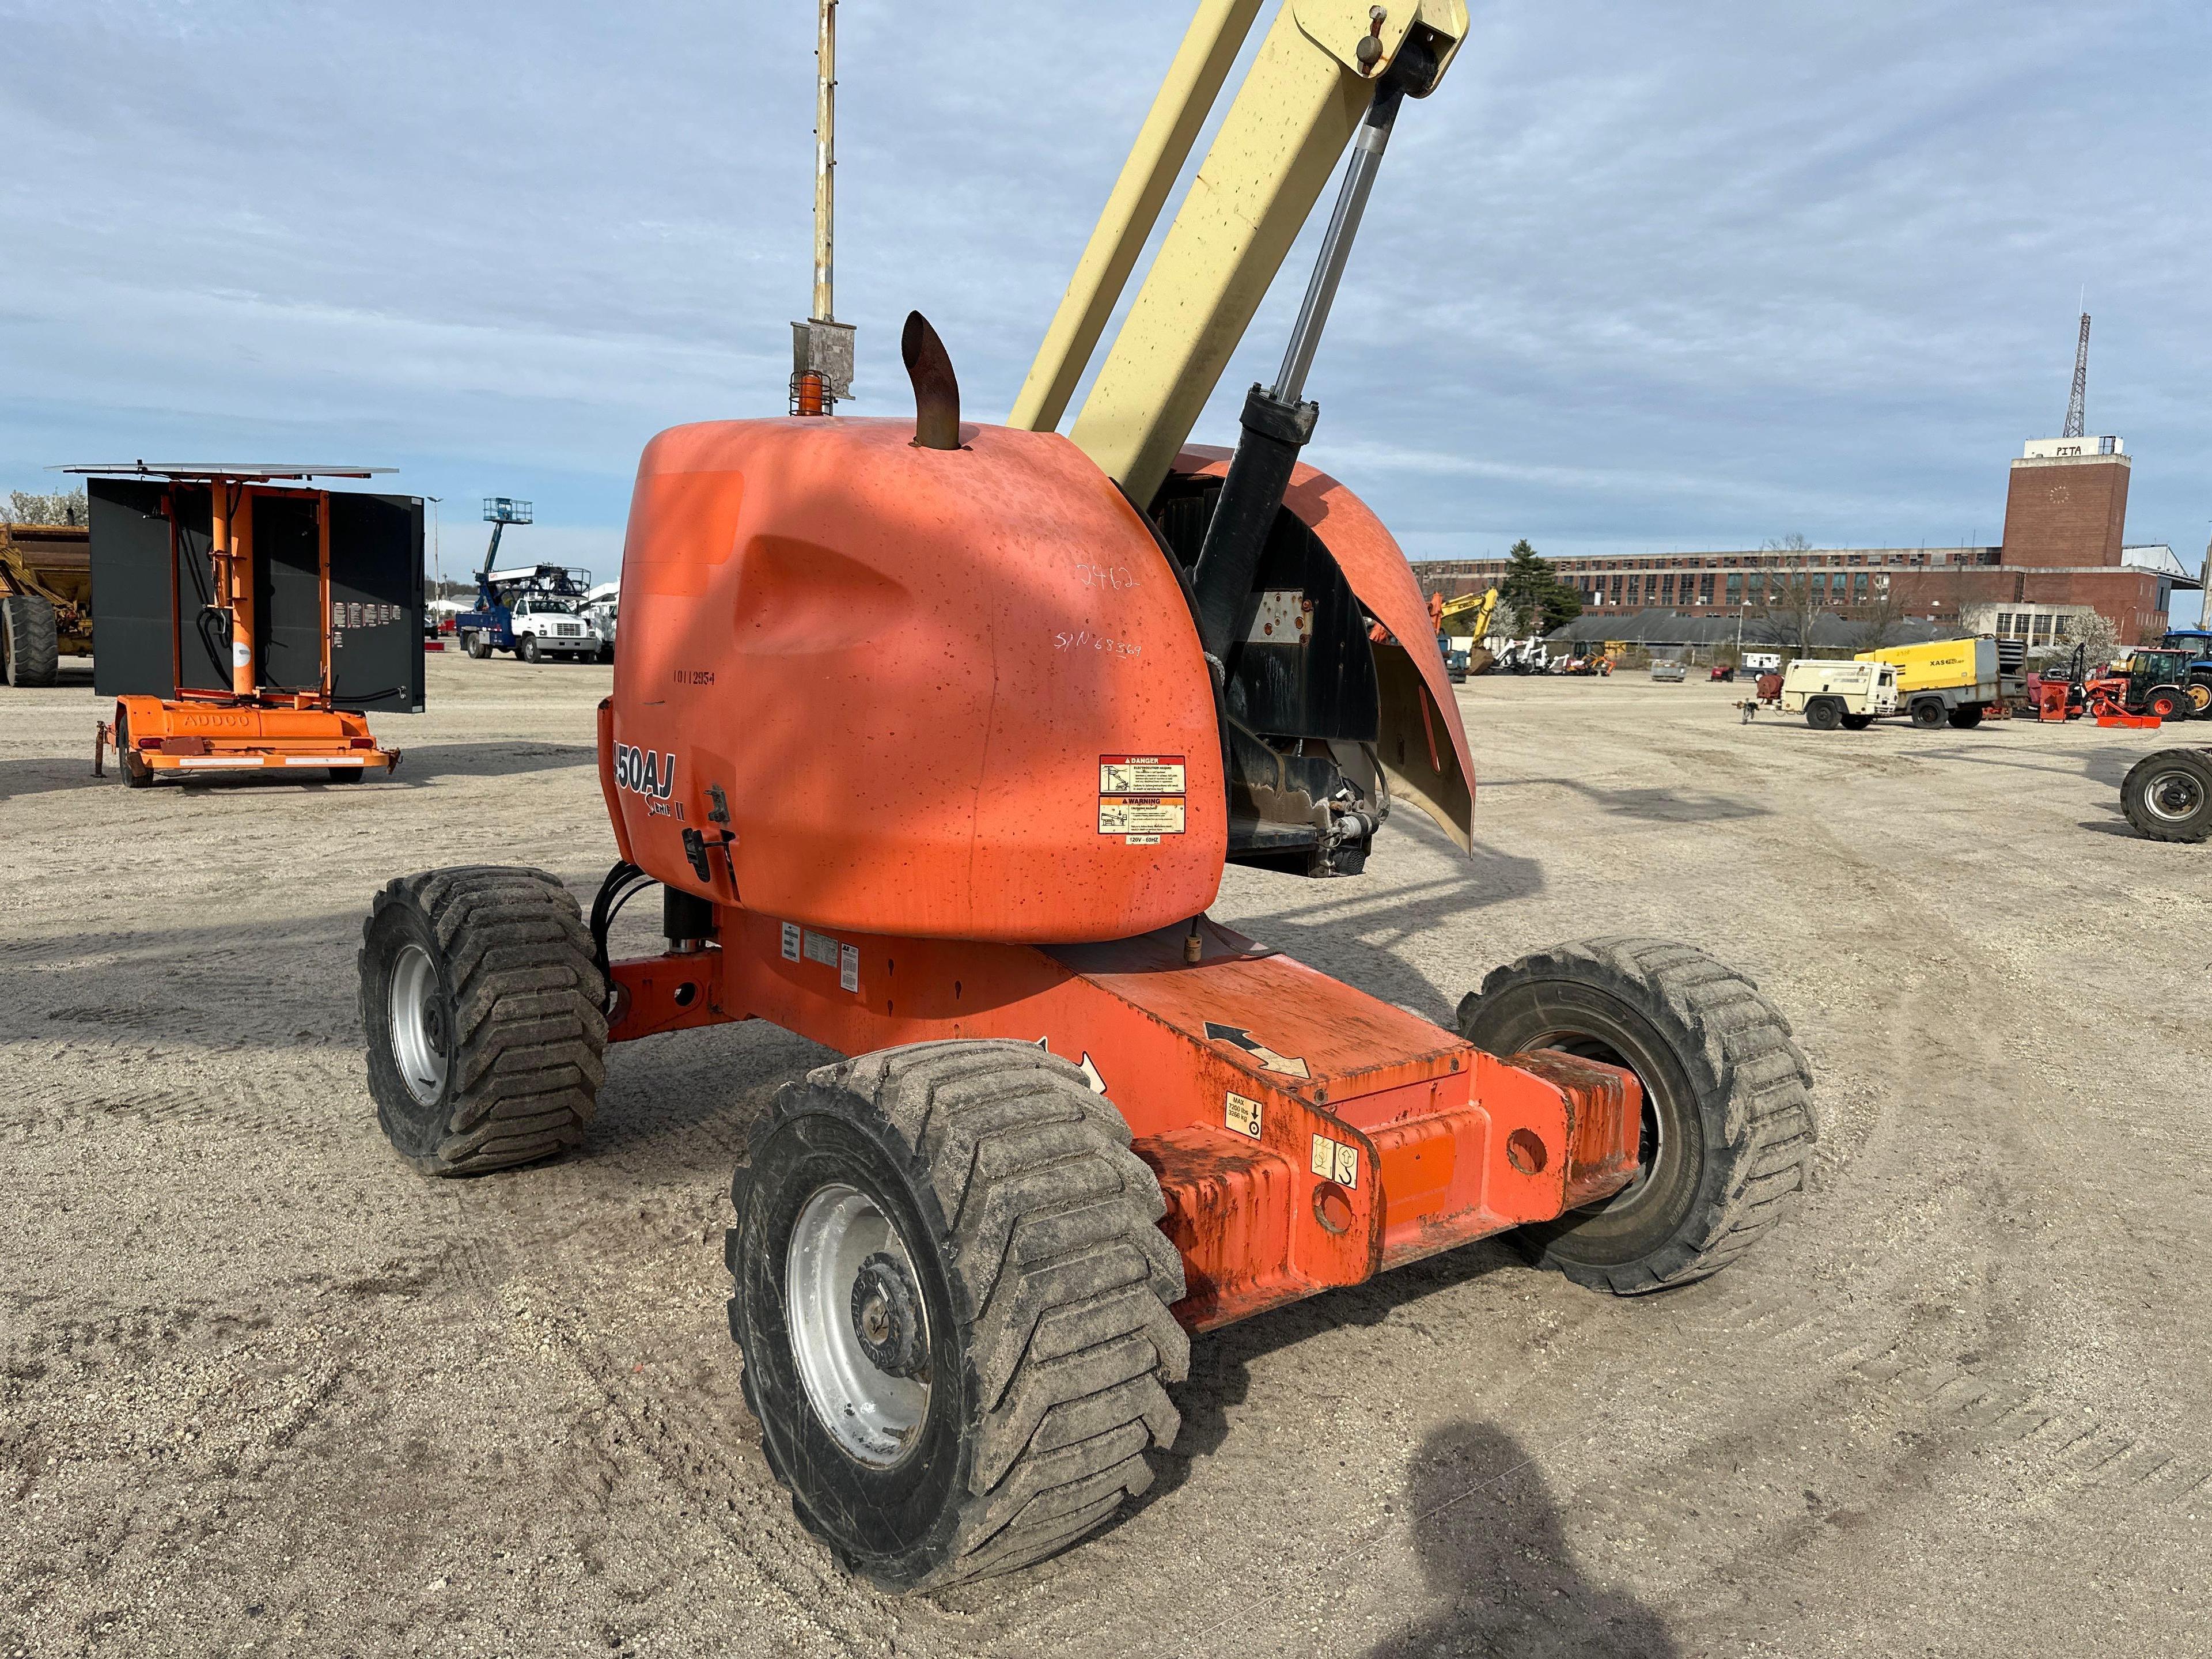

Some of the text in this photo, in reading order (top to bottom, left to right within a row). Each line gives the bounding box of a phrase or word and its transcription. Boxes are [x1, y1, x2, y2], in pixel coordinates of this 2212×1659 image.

[2057, 446, 2081, 456] PITA
[1077, 563, 1141, 590] 2462
[674, 670, 715, 685] 10112954
[185, 715, 249, 726] ADDCO
[1233, 1097, 1244, 1105] MAX
[1241, 1107, 1249, 1115] lbs
[1241, 1113, 1247, 1123] kg
[1669, 1120, 1699, 1225] OUTRIGGER
